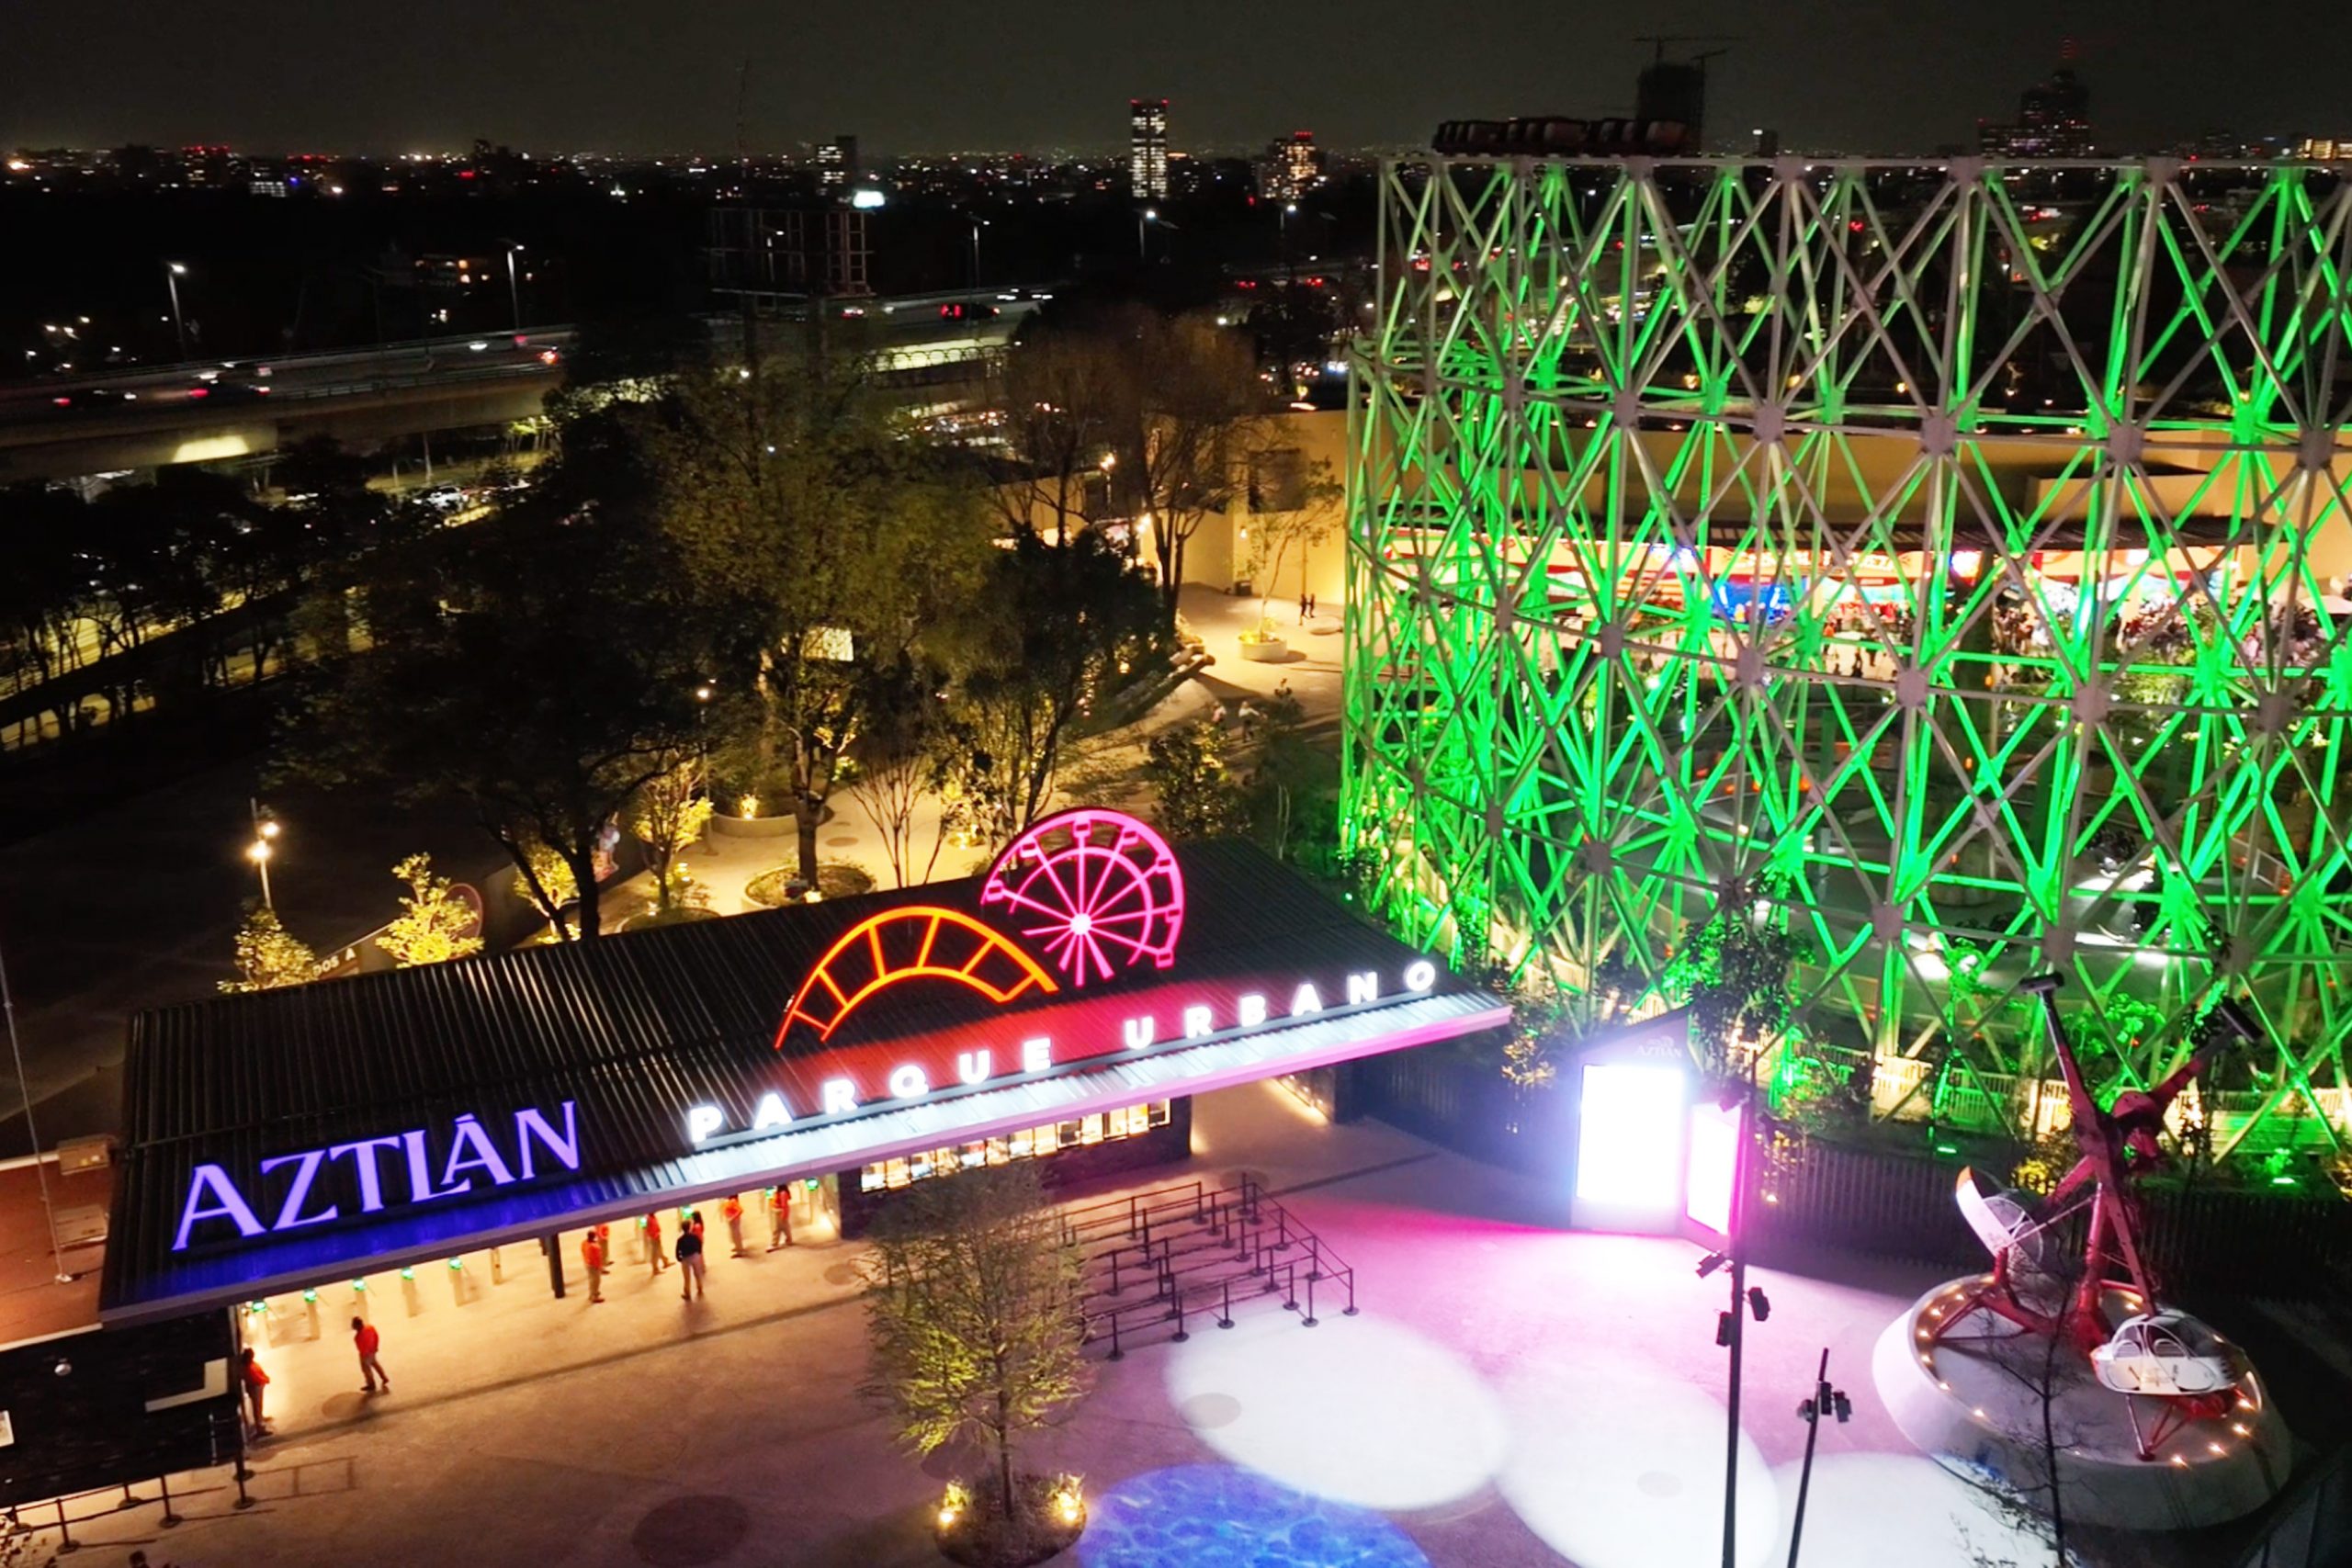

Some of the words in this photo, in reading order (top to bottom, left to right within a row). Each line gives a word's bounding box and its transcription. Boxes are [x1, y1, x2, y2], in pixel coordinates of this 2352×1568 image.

[688, 1037, 1052, 1145] PARQUE
[1125, 961, 1436, 1051] URBANO
[172, 1100, 580, 1250] AZTLÁN
